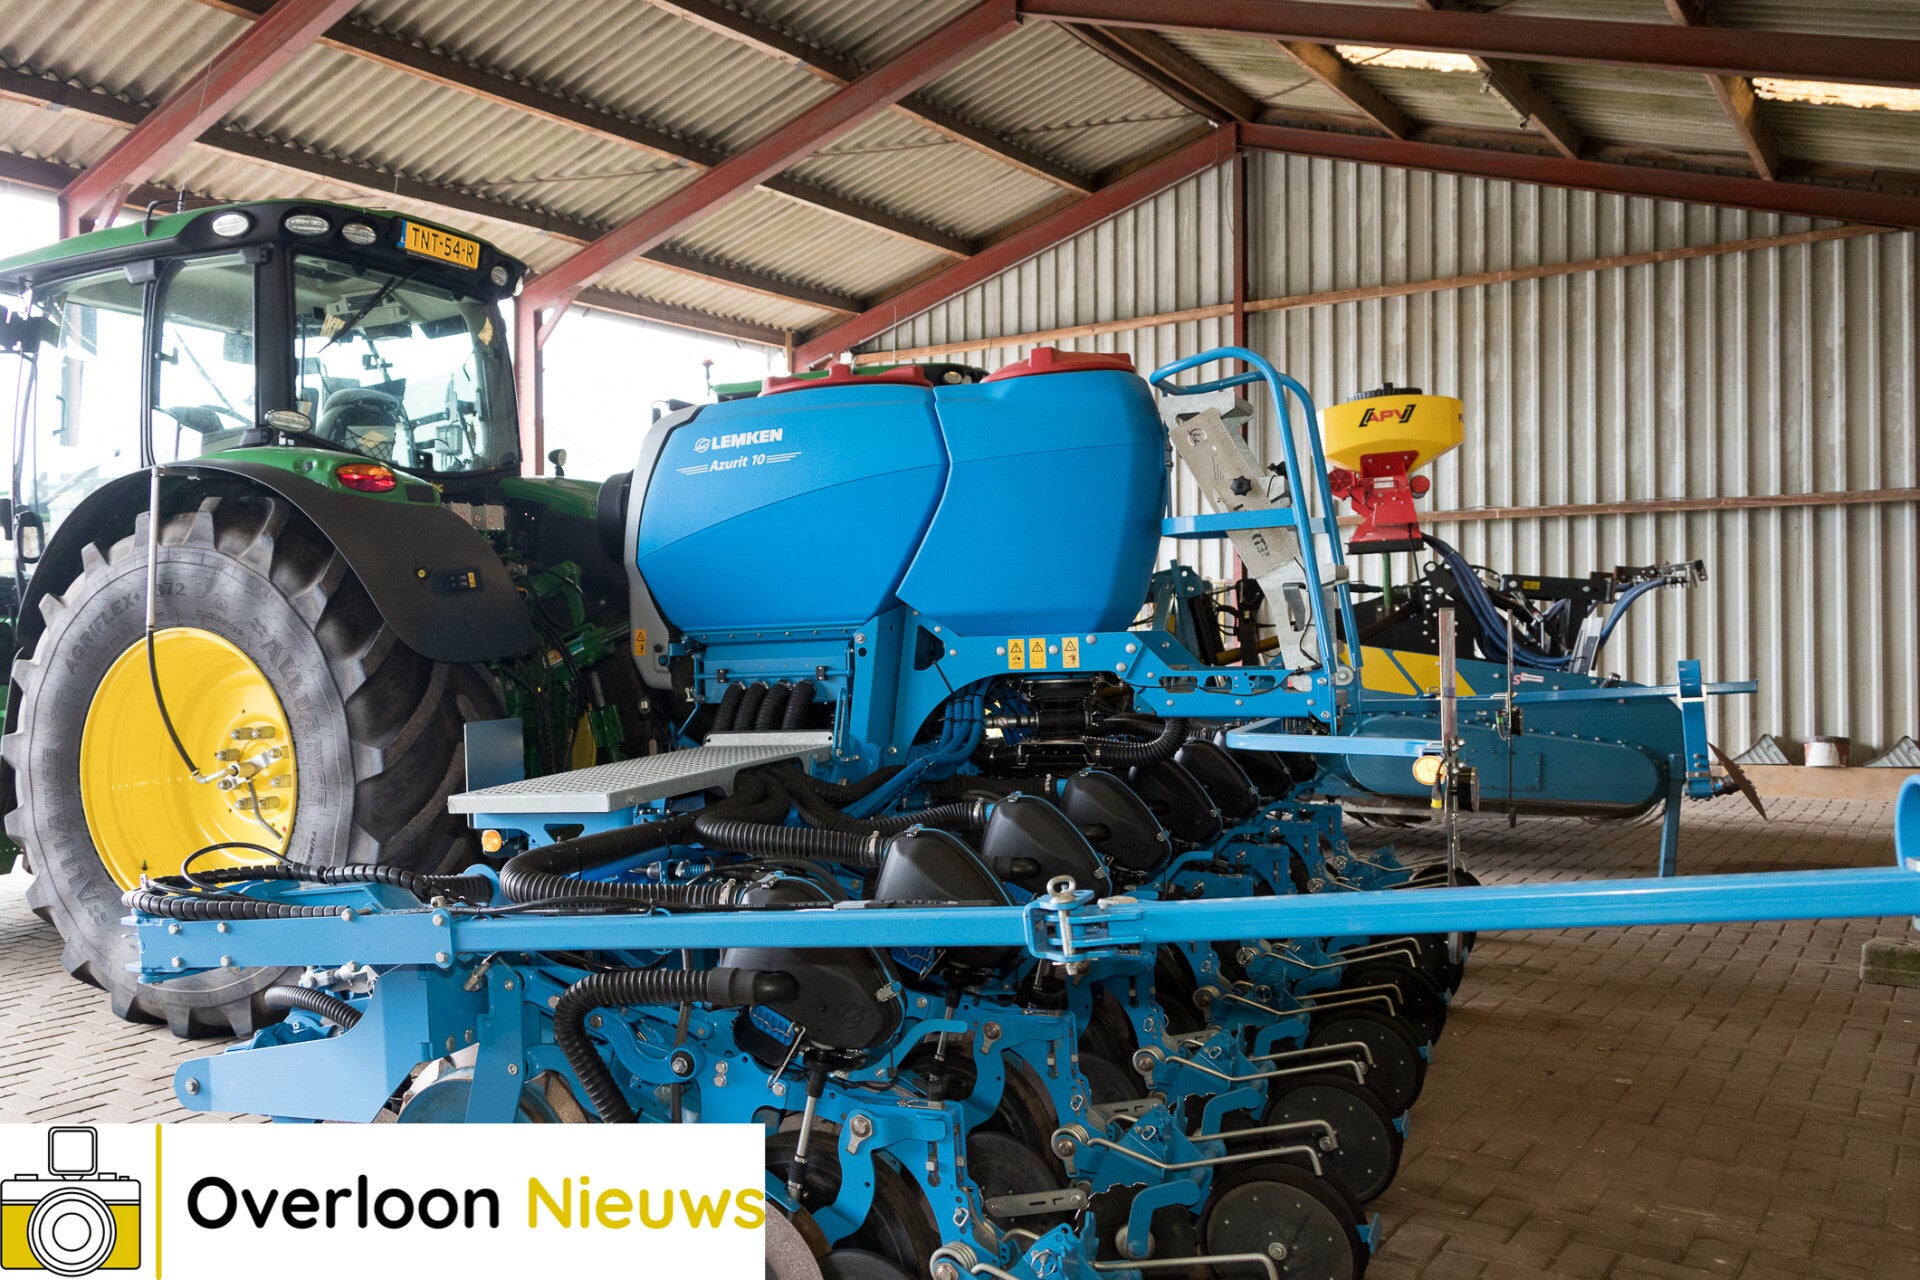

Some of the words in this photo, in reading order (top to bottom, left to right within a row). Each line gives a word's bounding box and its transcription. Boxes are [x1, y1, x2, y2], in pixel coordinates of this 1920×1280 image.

[412, 227, 474, 263] TNT-54-R
[711, 428, 784, 450] LEMKEN
[709, 456, 749, 472] Azurit
[752, 453, 766, 466] 10
